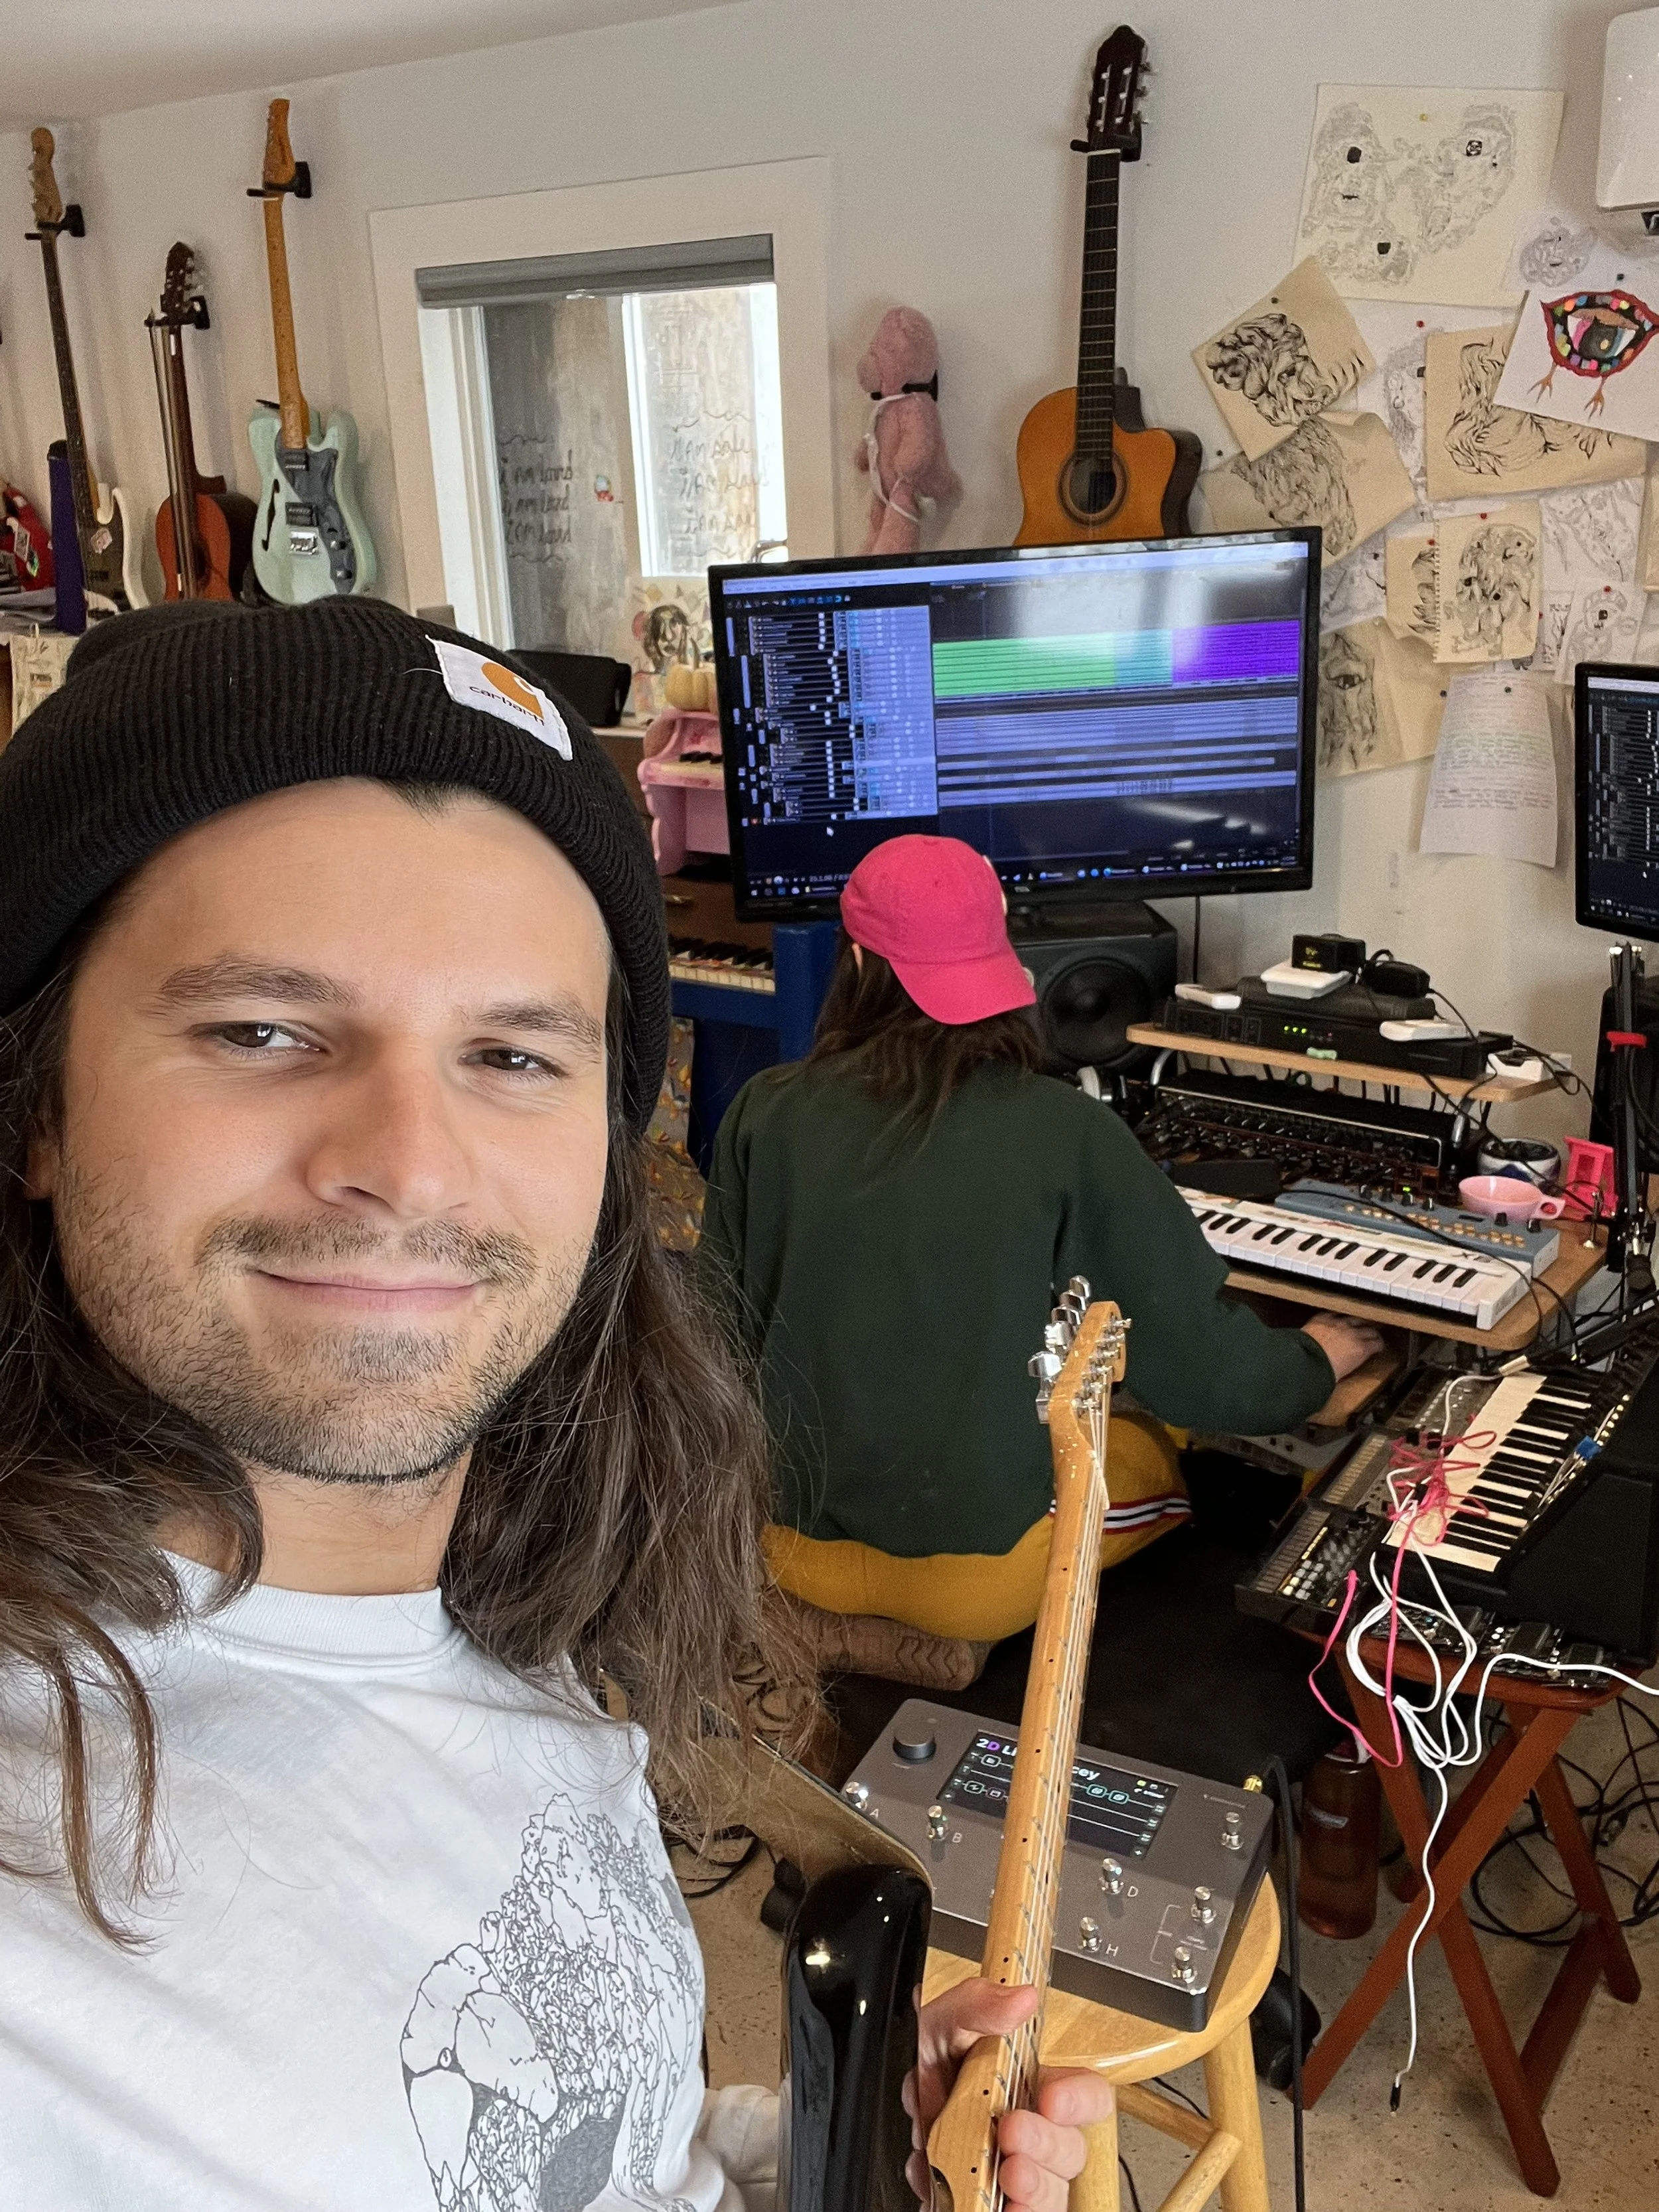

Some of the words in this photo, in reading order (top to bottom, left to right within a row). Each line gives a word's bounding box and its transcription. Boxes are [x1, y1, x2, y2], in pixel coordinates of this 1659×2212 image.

[469, 686, 545, 727] carhartt
[976, 1737, 1000, 1751] 2D
[869, 1808, 879, 1818] A
[952, 1832, 963, 1843] B
[1127, 1886, 1139, 1897] D
[1106, 1943, 1119, 1957] H
